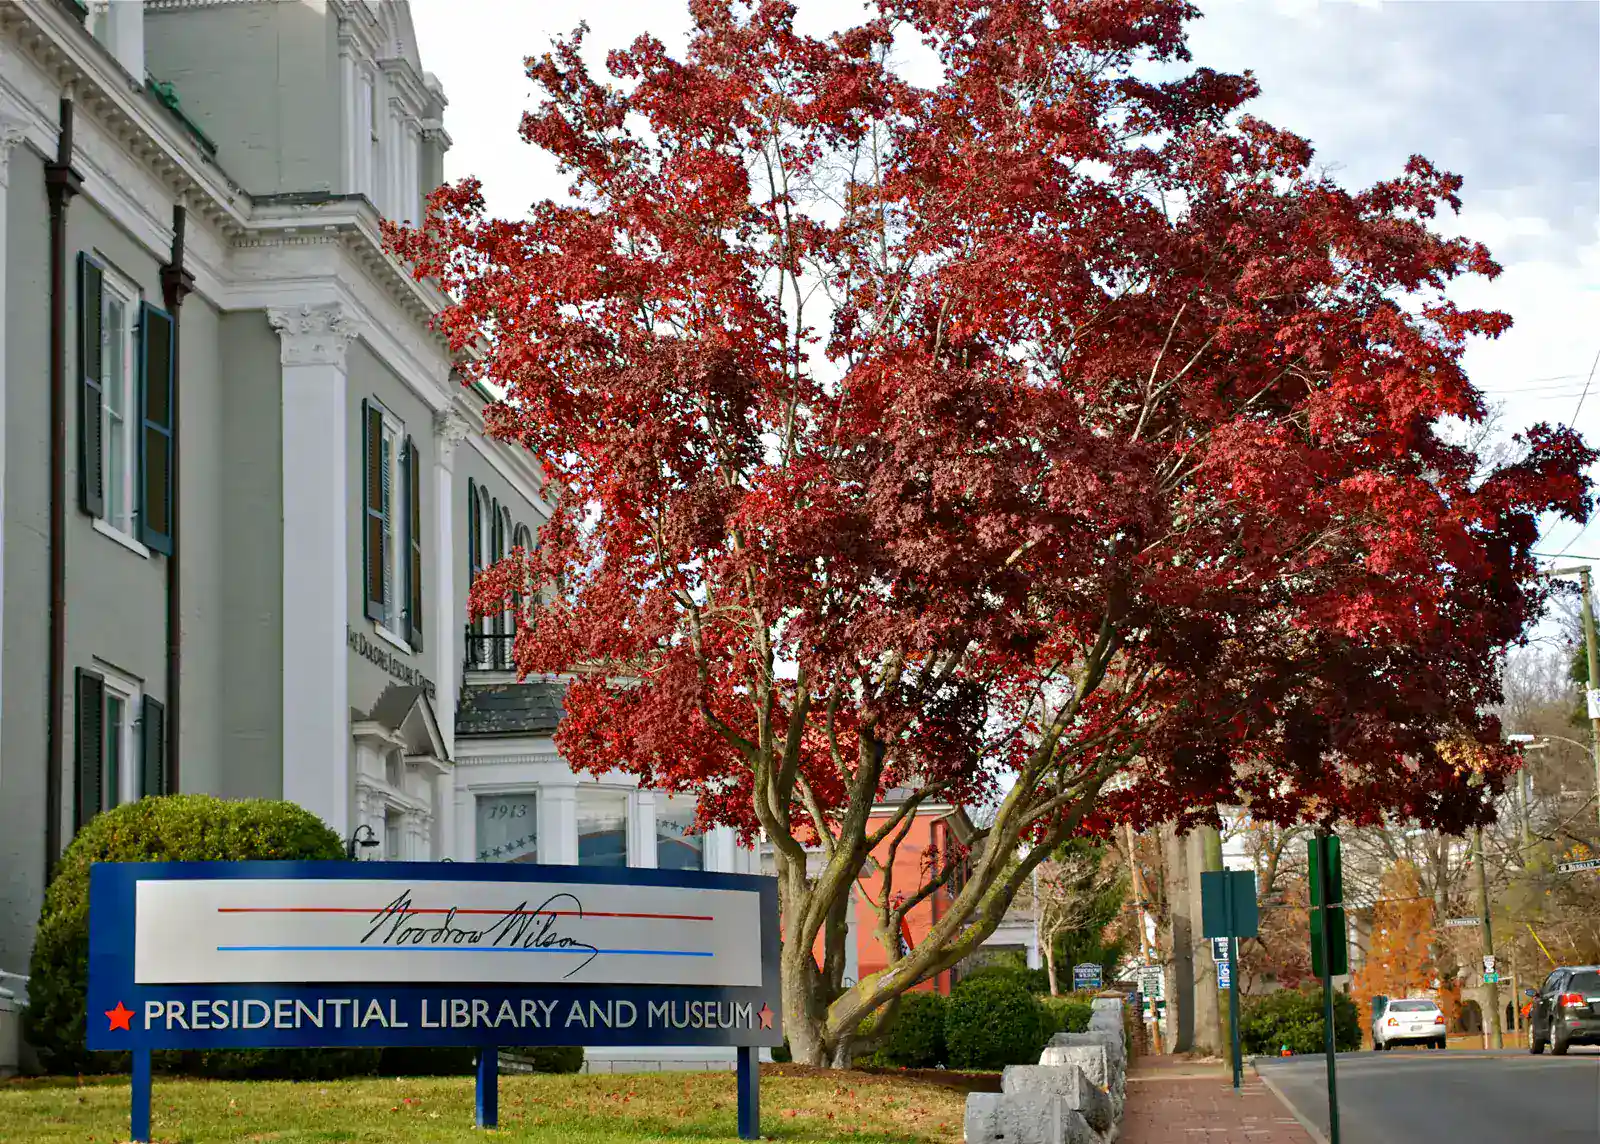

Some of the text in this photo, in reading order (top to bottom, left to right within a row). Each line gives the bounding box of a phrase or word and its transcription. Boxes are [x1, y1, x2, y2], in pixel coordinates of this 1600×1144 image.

[488, 804, 528, 819] 1913
[362, 889, 599, 978] Woodrow Wilson
[144, 998, 754, 1031] PRESIDENTIAL LIBRARY AND MUSEUM
